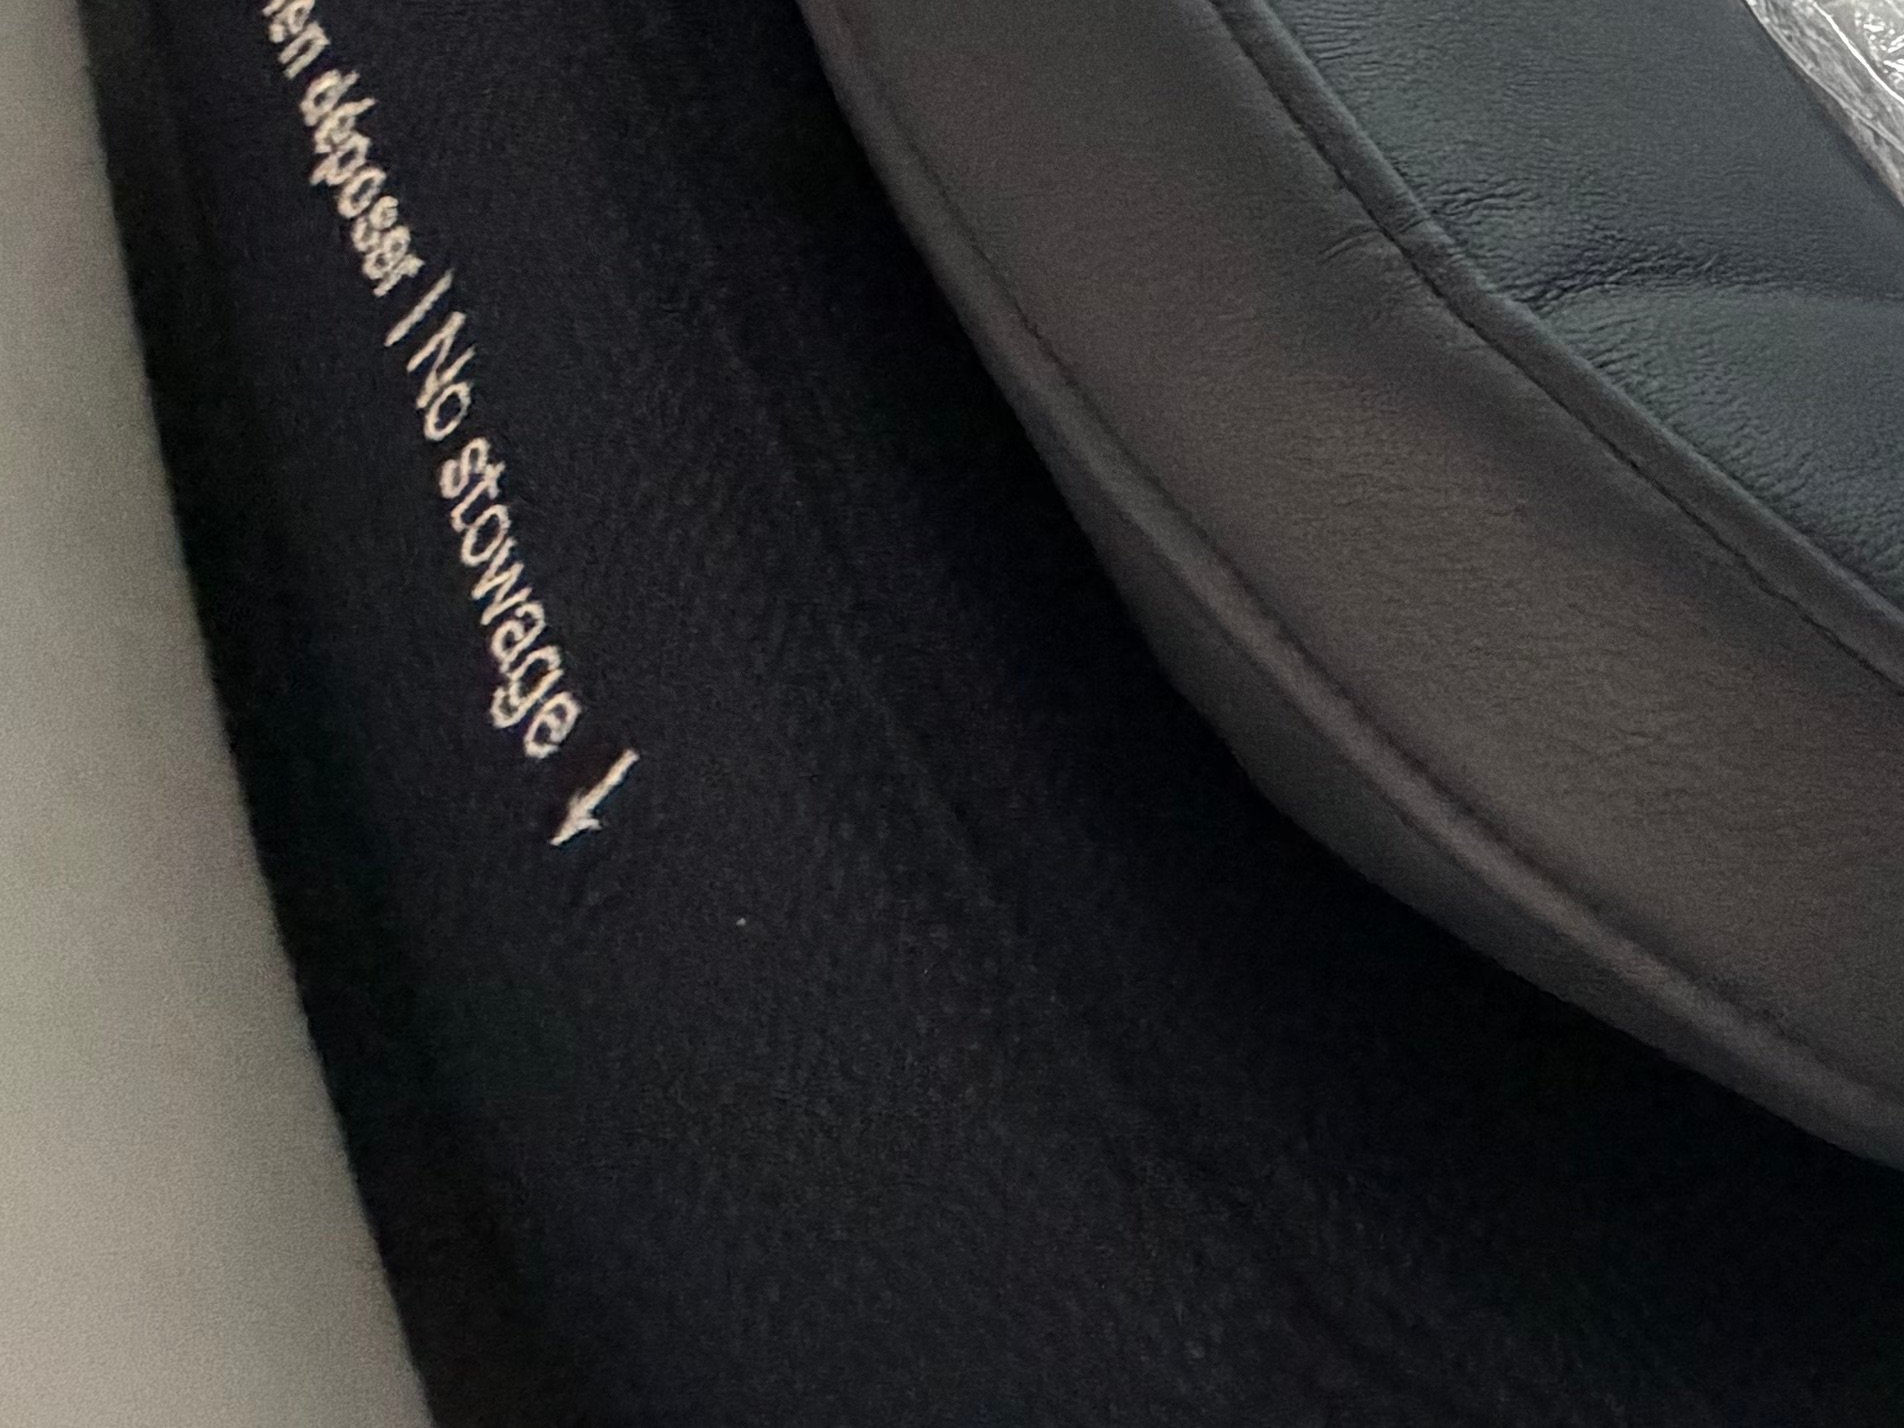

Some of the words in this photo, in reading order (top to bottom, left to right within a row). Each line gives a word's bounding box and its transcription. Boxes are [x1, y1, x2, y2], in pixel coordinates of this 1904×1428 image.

[299, 67, 426, 297] déposer
[407, 311, 474, 442] No
[440, 437, 582, 759] stowage
